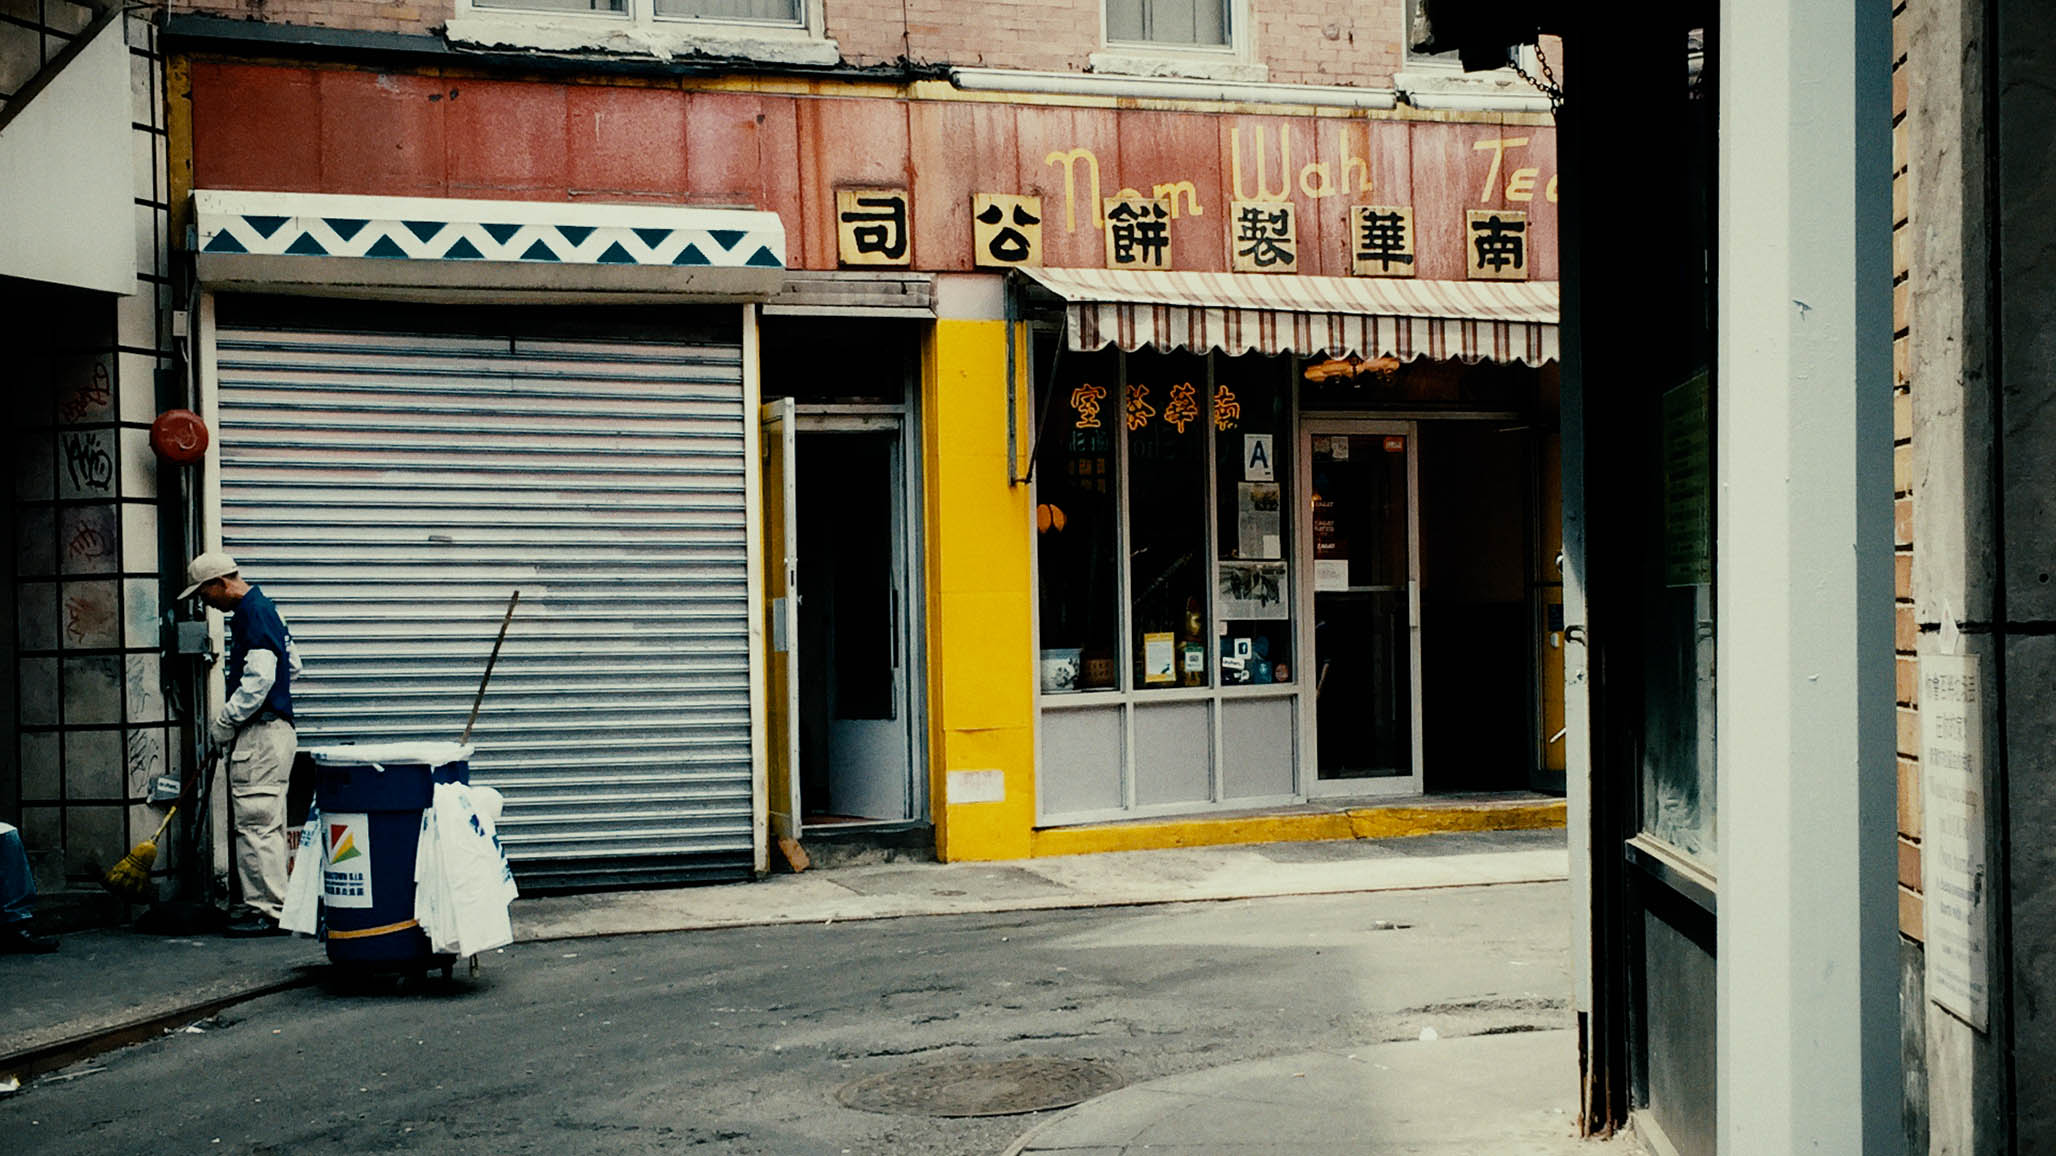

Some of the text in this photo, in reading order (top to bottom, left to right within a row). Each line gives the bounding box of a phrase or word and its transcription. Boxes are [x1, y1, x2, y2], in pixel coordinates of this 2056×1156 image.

[1045, 147, 1203, 233] Nm
[1231, 122, 1373, 203] Wah
[1249, 440, 1269, 468] A
